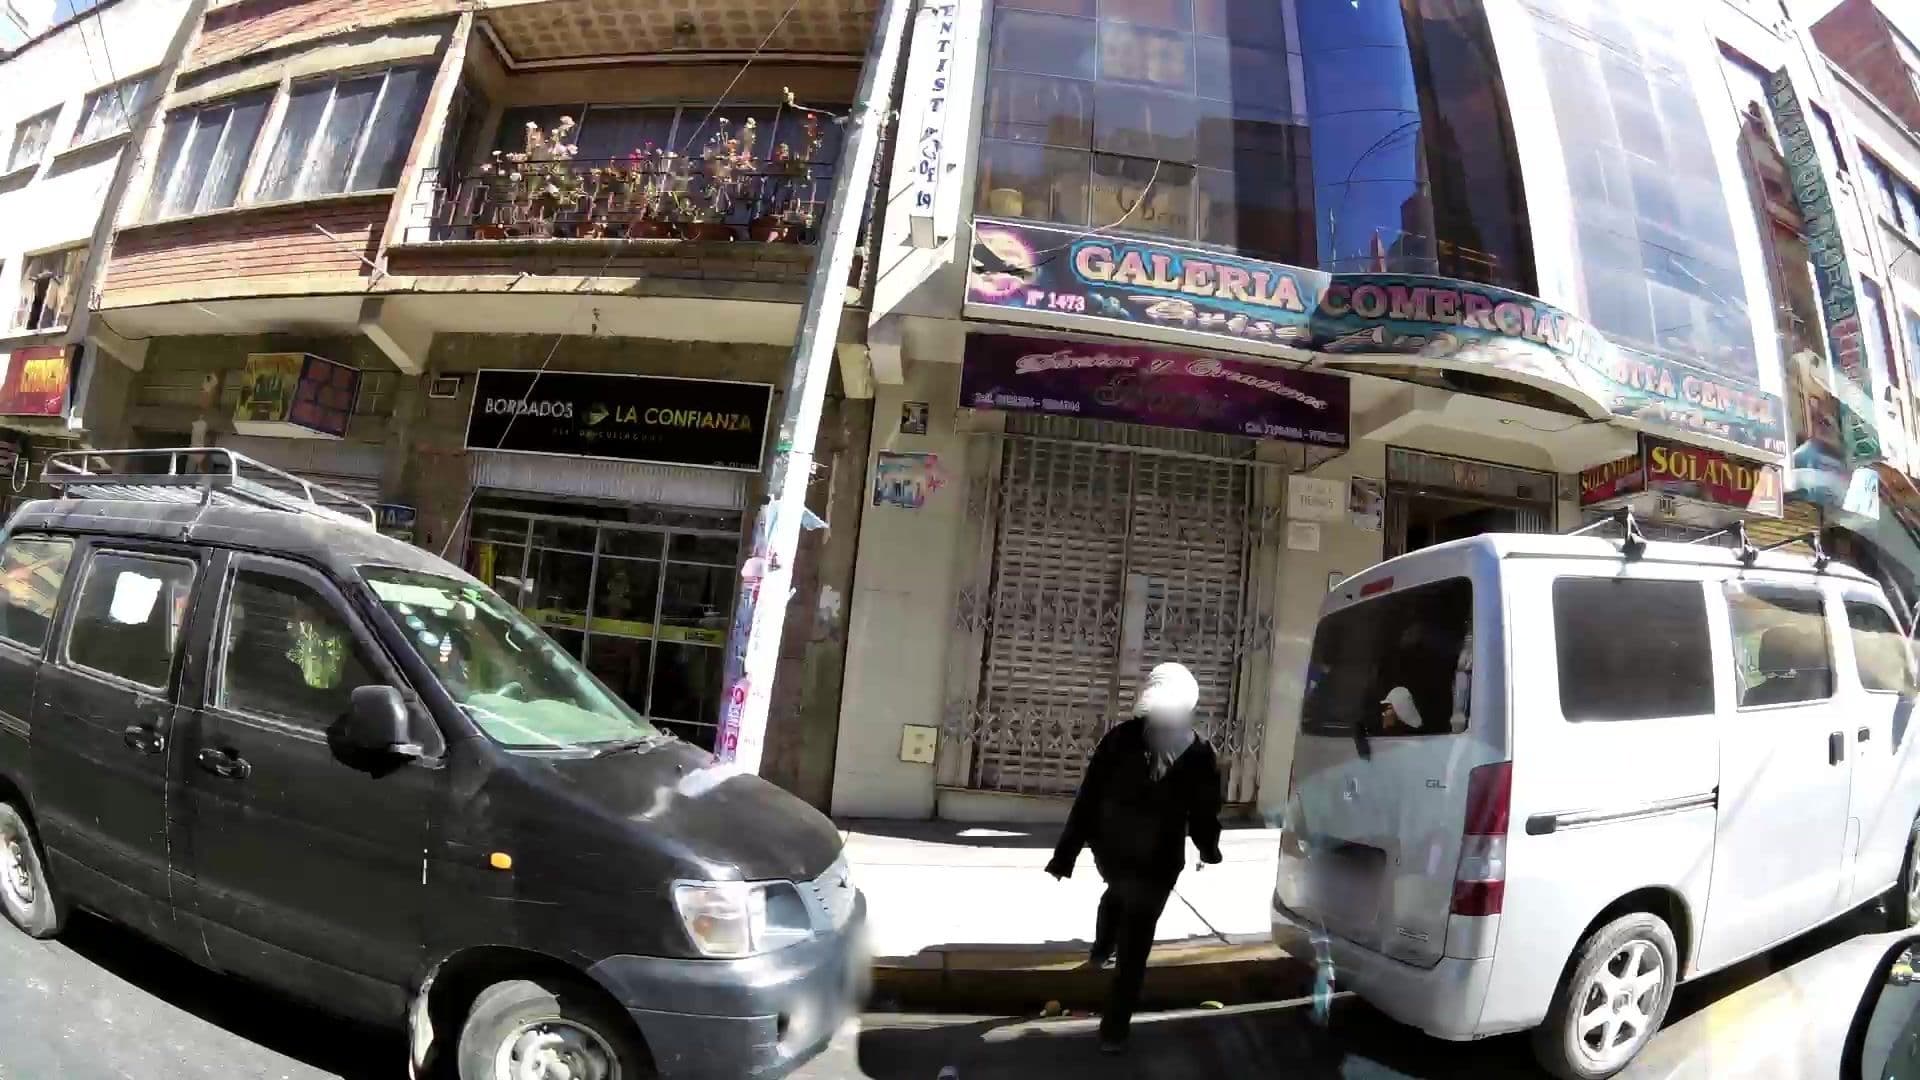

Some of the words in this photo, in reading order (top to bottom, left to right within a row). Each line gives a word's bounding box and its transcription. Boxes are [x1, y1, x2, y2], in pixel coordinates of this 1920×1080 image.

[1076, 246, 1305, 311] GALERIA
[1047, 291, 1085, 313] 1473
[485, 398, 573, 418] BORDADOS
[615, 405, 638, 425] LA
[644, 408, 752, 431] CONFIANZA
